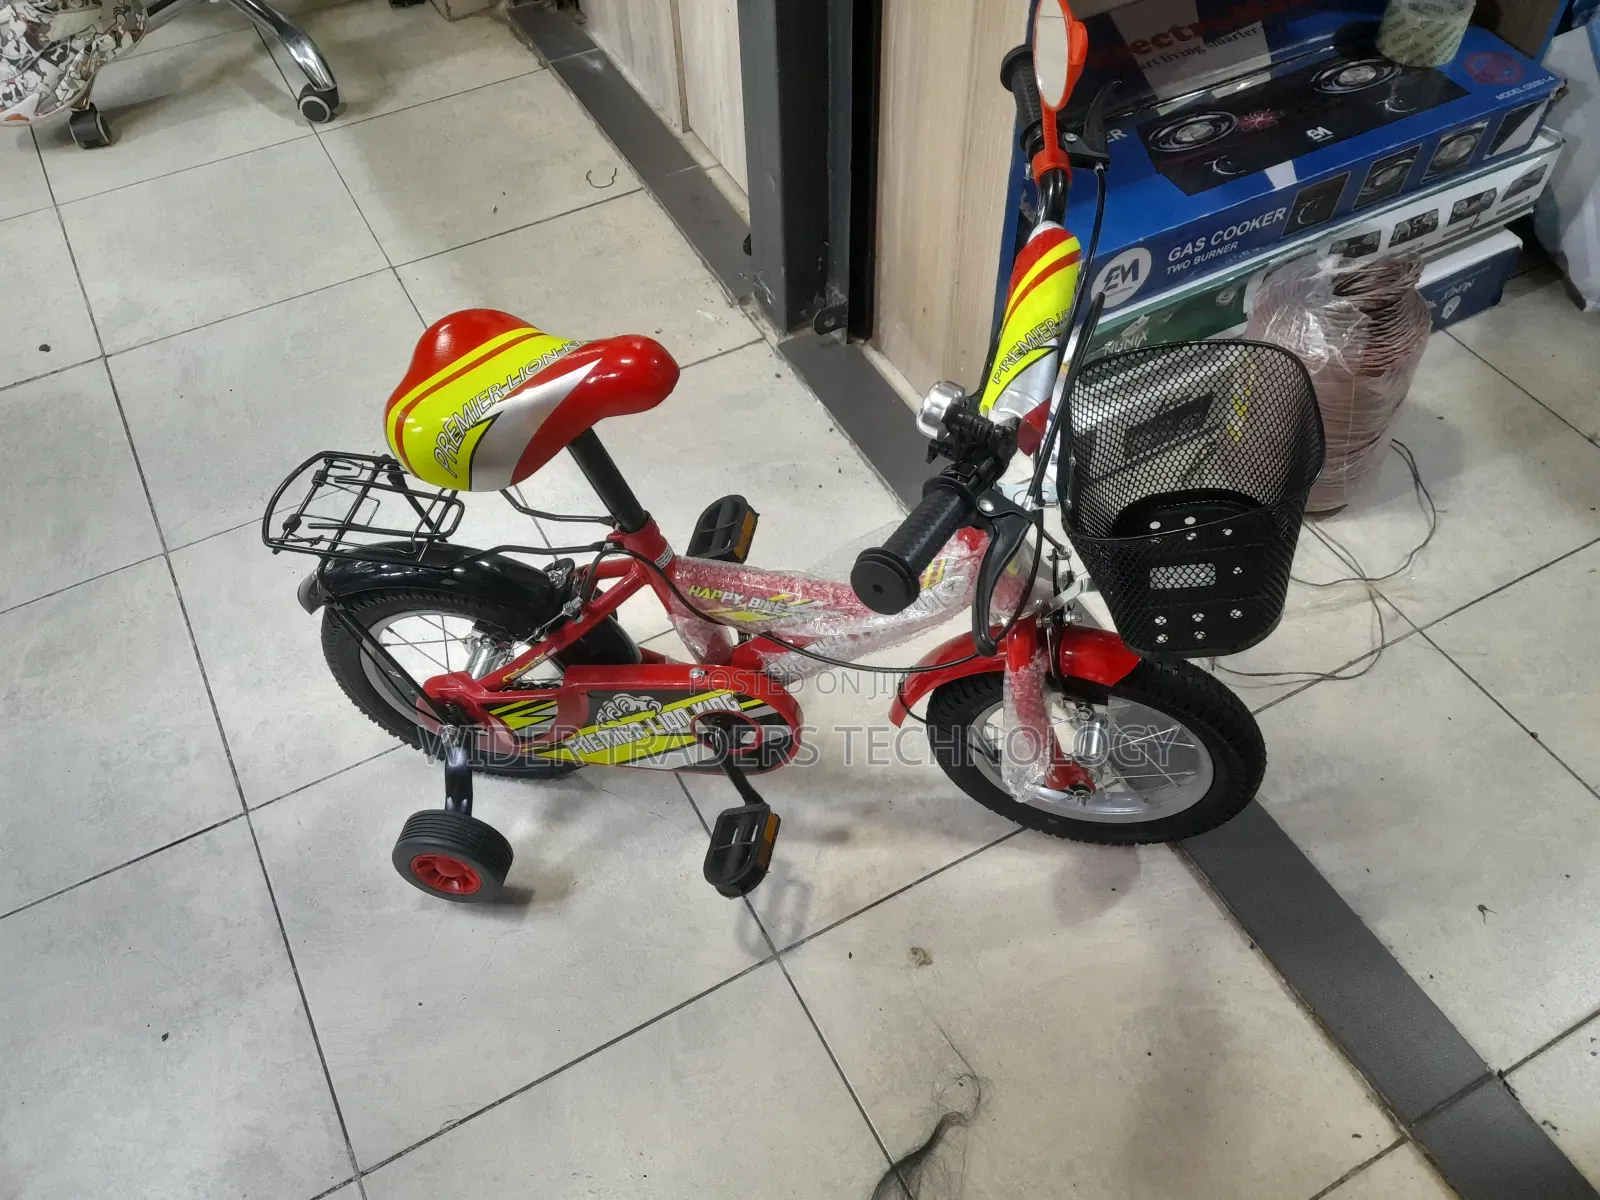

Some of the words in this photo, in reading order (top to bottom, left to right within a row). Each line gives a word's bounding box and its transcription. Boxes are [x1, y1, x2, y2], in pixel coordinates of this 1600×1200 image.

[1166, 260, 1191, 276] TWO
[1193, 240, 1239, 264] BURNER
[1168, 237, 1205, 262] GAS
[1210, 207, 1287, 246] COOKER
[992, 317, 1060, 385] PREMIER
[432, 382, 505, 478] PREMIER
[507, 350, 560, 392] LION
[687, 584, 745, 605] HAPPY
[563, 721, 651, 757] PREMIER
[646, 706, 693, 735] LION
[691, 692, 742, 712] KING
